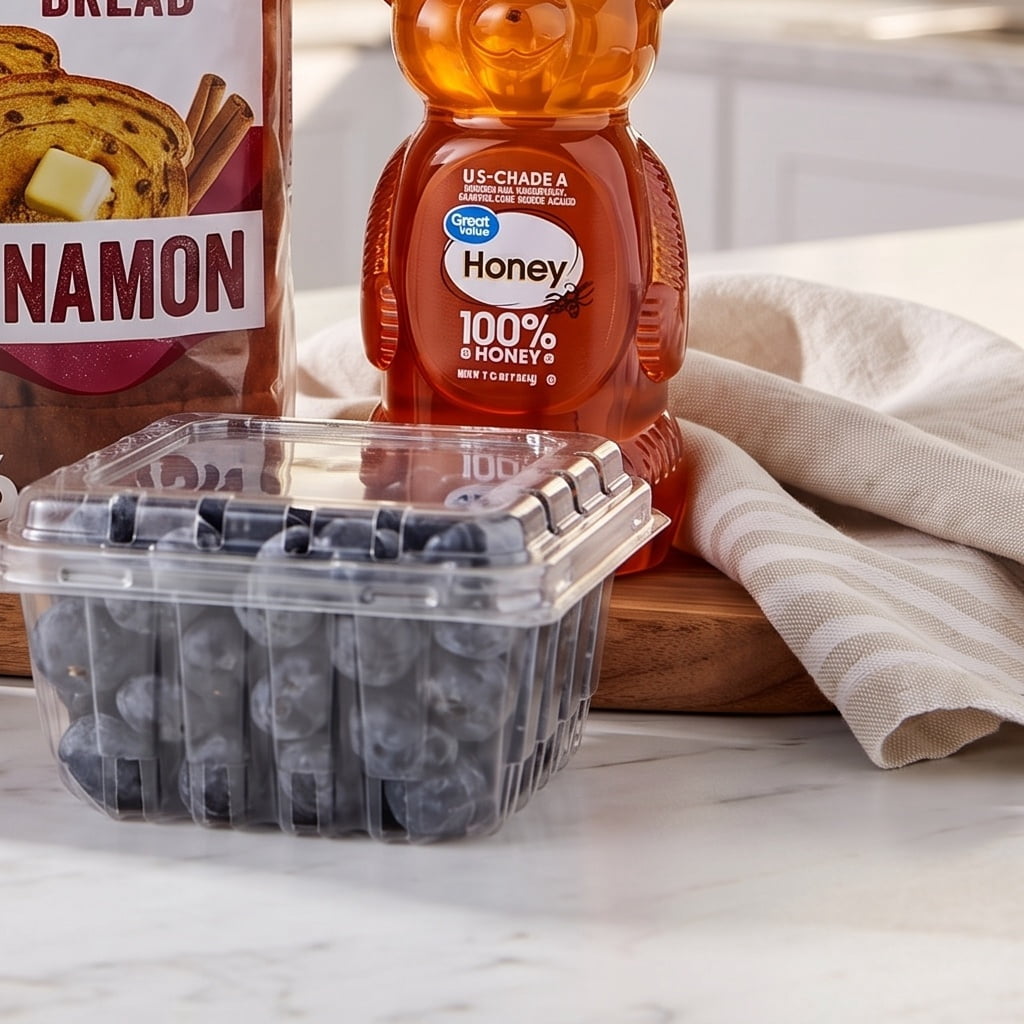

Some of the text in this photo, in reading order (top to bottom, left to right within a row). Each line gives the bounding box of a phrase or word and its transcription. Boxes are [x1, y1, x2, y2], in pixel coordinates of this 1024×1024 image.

[556, 172, 568, 187] A
[451, 213, 490, 228] Great
[463, 250, 568, 288] Honey
[459, 311, 556, 350] 100%
[475, 346, 541, 365] HONEY
